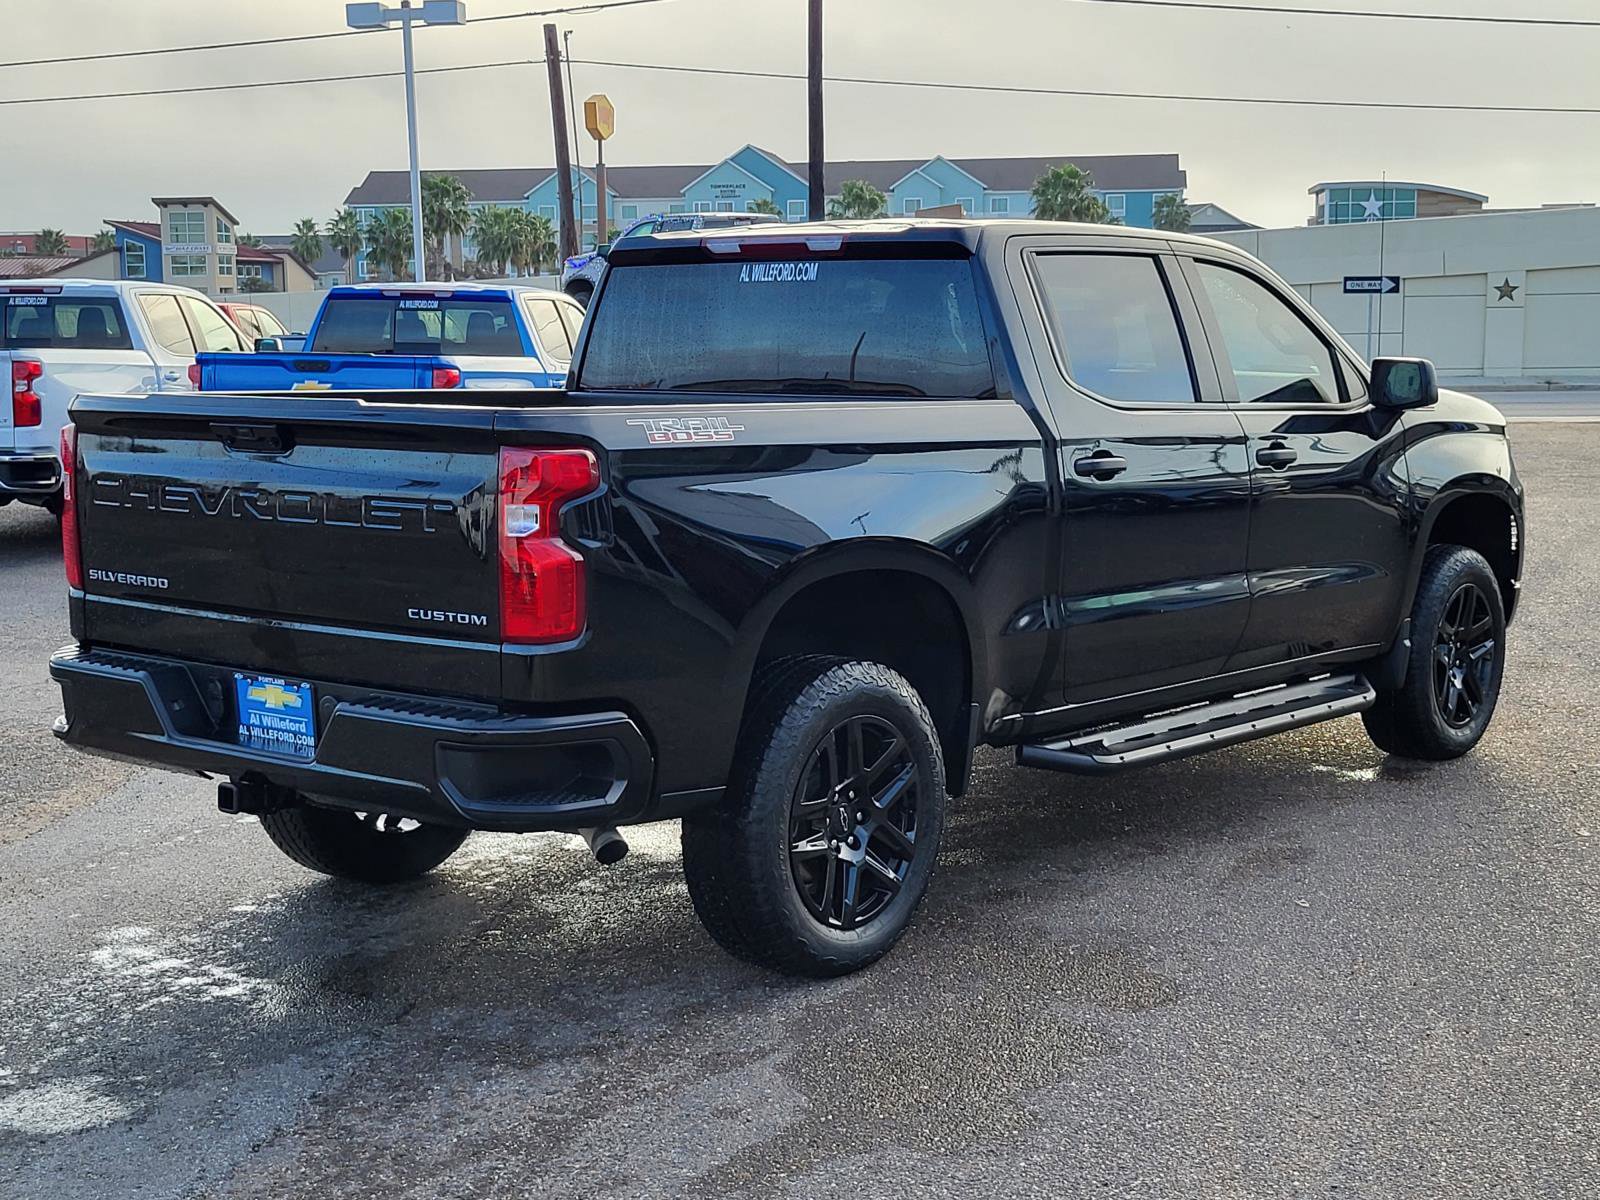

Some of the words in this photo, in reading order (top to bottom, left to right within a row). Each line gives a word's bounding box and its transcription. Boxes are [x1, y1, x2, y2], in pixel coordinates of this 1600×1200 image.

[739, 264, 750, 282] AL
[751, 263, 819, 282] WILLEFORD.COM
[626, 416, 745, 431] TRAIL
[647, 430, 735, 444] BOSS
[93, 479, 453, 532] CHEVROLET
[88, 568, 169, 590] SILVERADO
[407, 608, 488, 627] CUSTOM
[258, 676, 285, 685] PORTLAND
[249, 713, 260, 725] Al
[261, 715, 306, 733] Willeford
[239, 725, 249, 735] AL
[250, 726, 315, 746] WILLEFORD.COM
